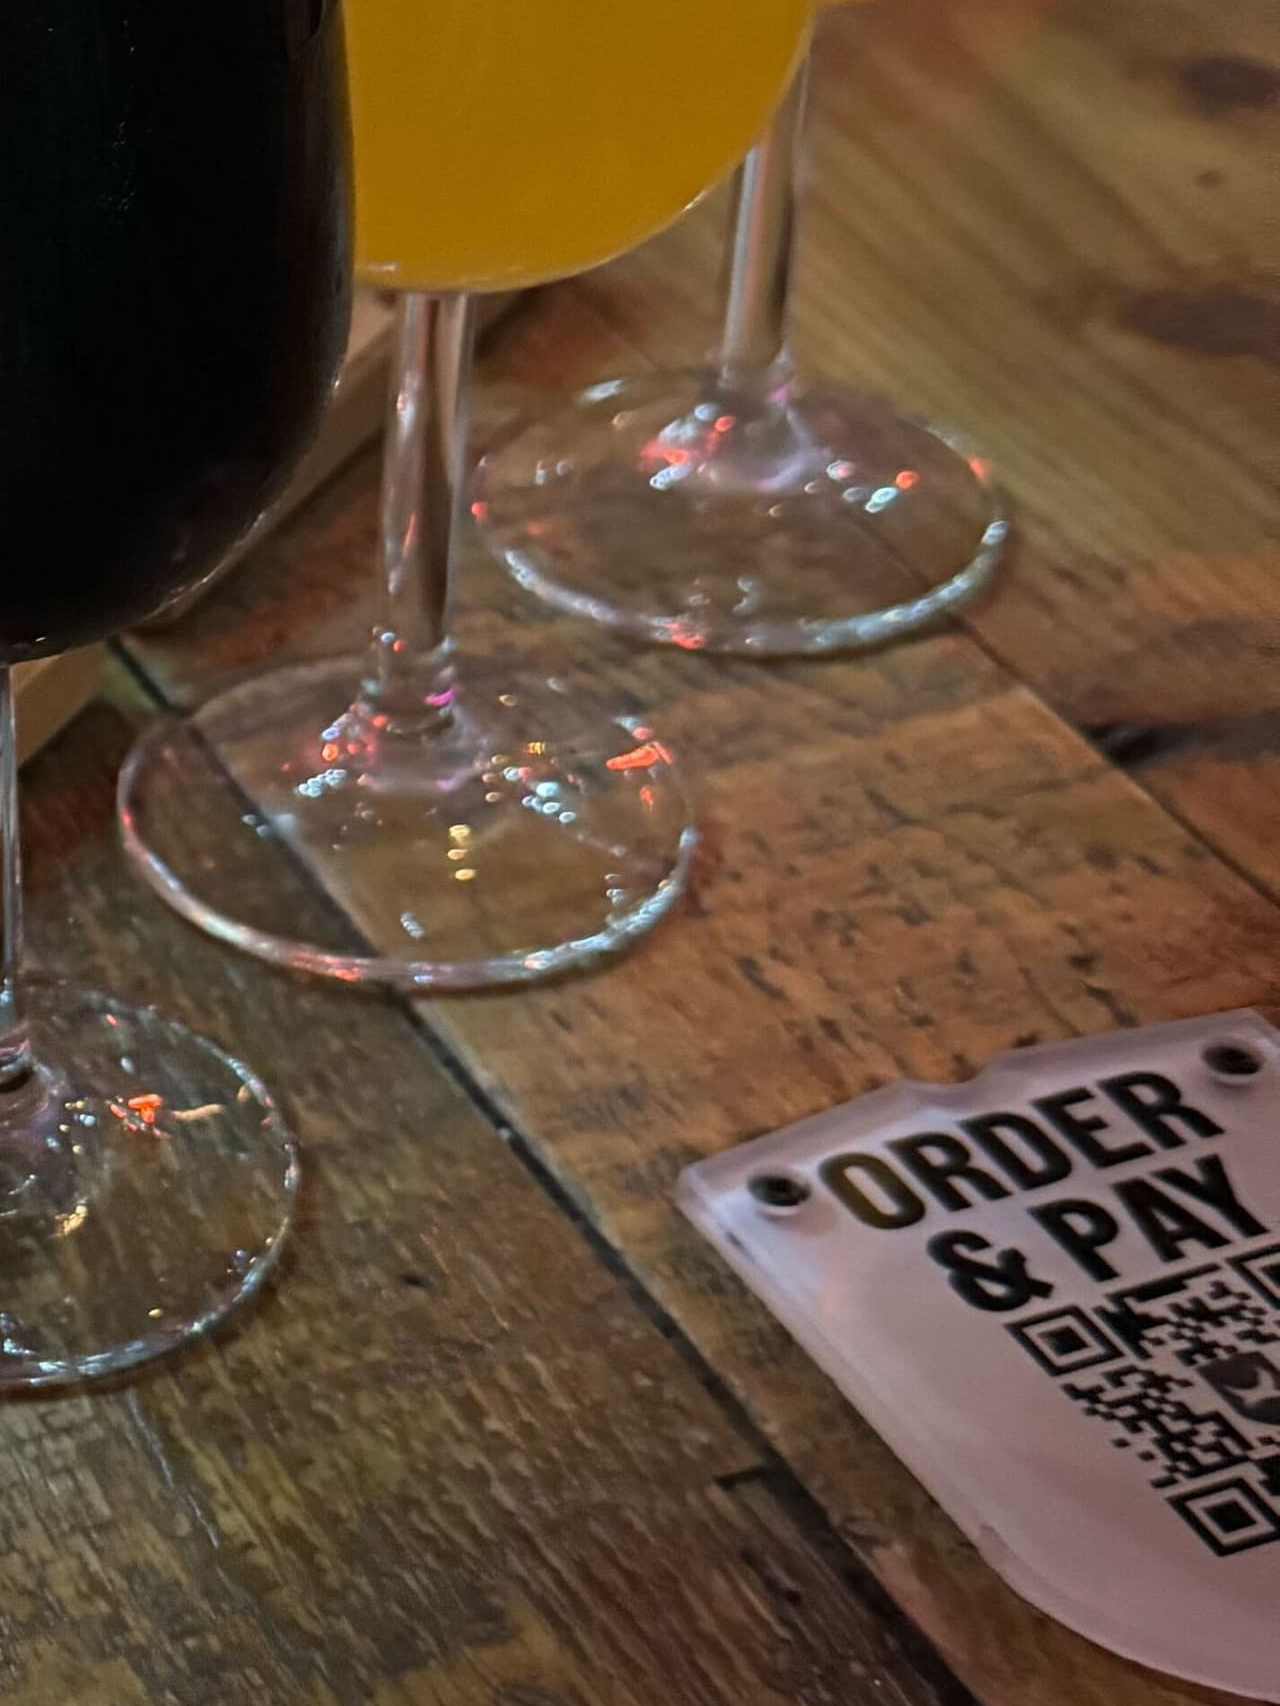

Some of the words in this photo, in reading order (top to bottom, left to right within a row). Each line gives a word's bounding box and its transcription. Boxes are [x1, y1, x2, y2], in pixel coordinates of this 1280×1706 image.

[818, 1070, 1226, 1231] ORDER
[926, 1229, 1054, 1313] &
[1028, 1154, 1269, 1283] PAY
